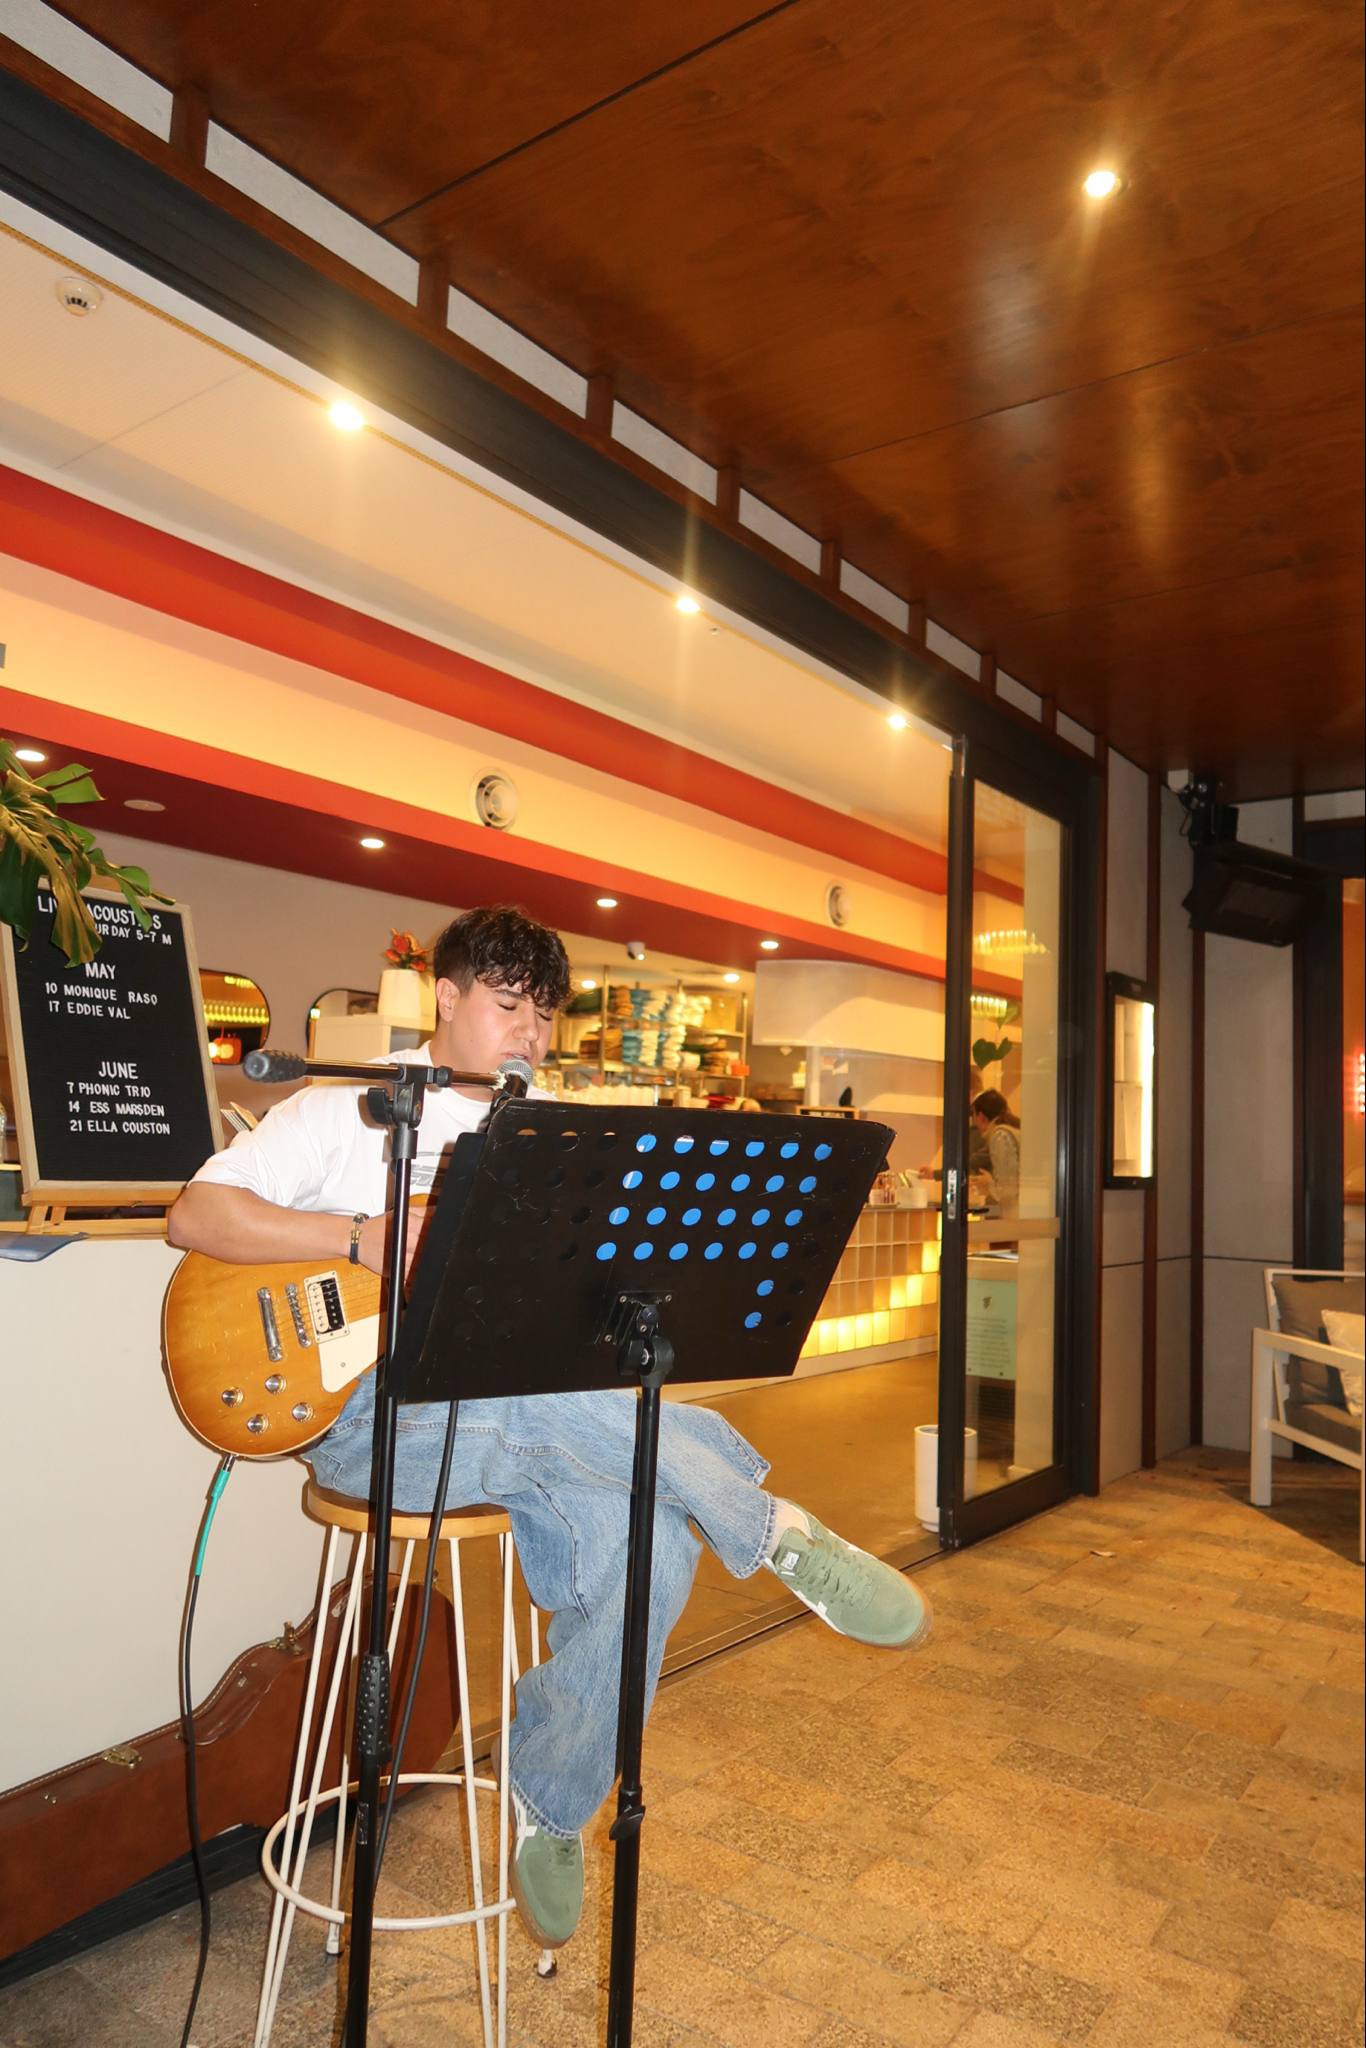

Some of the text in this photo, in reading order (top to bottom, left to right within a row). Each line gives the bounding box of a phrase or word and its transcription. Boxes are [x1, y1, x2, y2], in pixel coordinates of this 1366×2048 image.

[37, 896, 162, 930] LI COUSTS
[94, 924, 172, 945] URDAY 5-7 M
[85, 962, 116, 980] MAY
[45, 982, 158, 1006] 10 MONIQUE RASO
[49, 1000, 131, 1020] 17 EDDIE VAL
[98, 1061, 138, 1079] JUNE
[66, 1082, 151, 1098] 7 PHONIC TRIO
[68, 1100, 165, 1117] 14 ESS MARSDEN
[70, 1119, 170, 1135] 21 ELLA COUSTON
